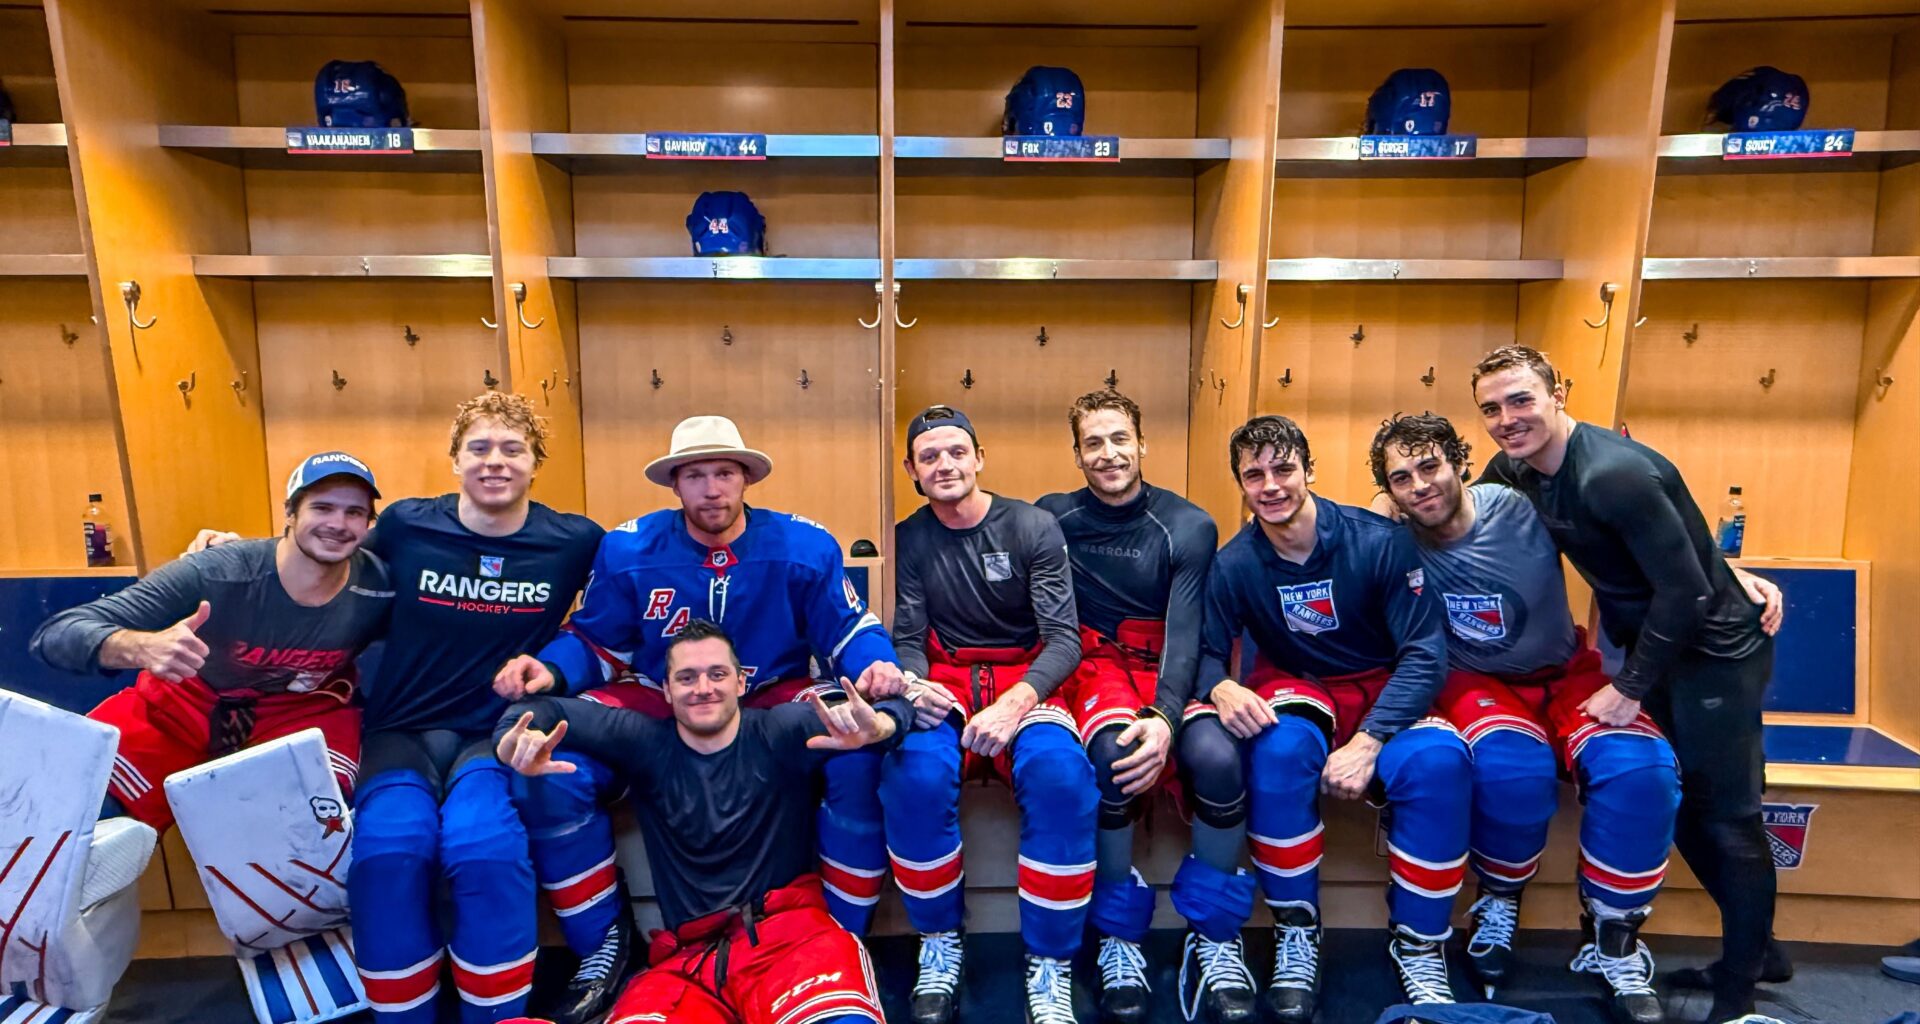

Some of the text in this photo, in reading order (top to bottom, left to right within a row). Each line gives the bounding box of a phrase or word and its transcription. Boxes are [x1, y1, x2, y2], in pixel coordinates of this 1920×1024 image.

[1056, 92, 1073, 109] 23
[1420, 91, 1436, 108] 17
[306, 132, 401, 148] VAAKANAINEN 18
[664, 139, 757, 155] GAVRIKOV 44
[1745, 135, 1844, 153] SOUCY 24
[1022, 141, 1110, 157] FOX 23
[1454, 141, 1469, 156] 17
[709, 218, 729, 234] 44
[1079, 543, 1142, 560] WARROAD
[419, 569, 551, 604] RANGERS
[1283, 587, 1329, 603] NEW YORK
[457, 601, 511, 615] HOCKEY
[1449, 600, 1470, 610] NEW
[1291, 604, 1334, 627] RANGERS
[234, 641, 348, 669] RANGER
[1774, 811, 1806, 824] YORK
[771, 972, 842, 1013] CCM
